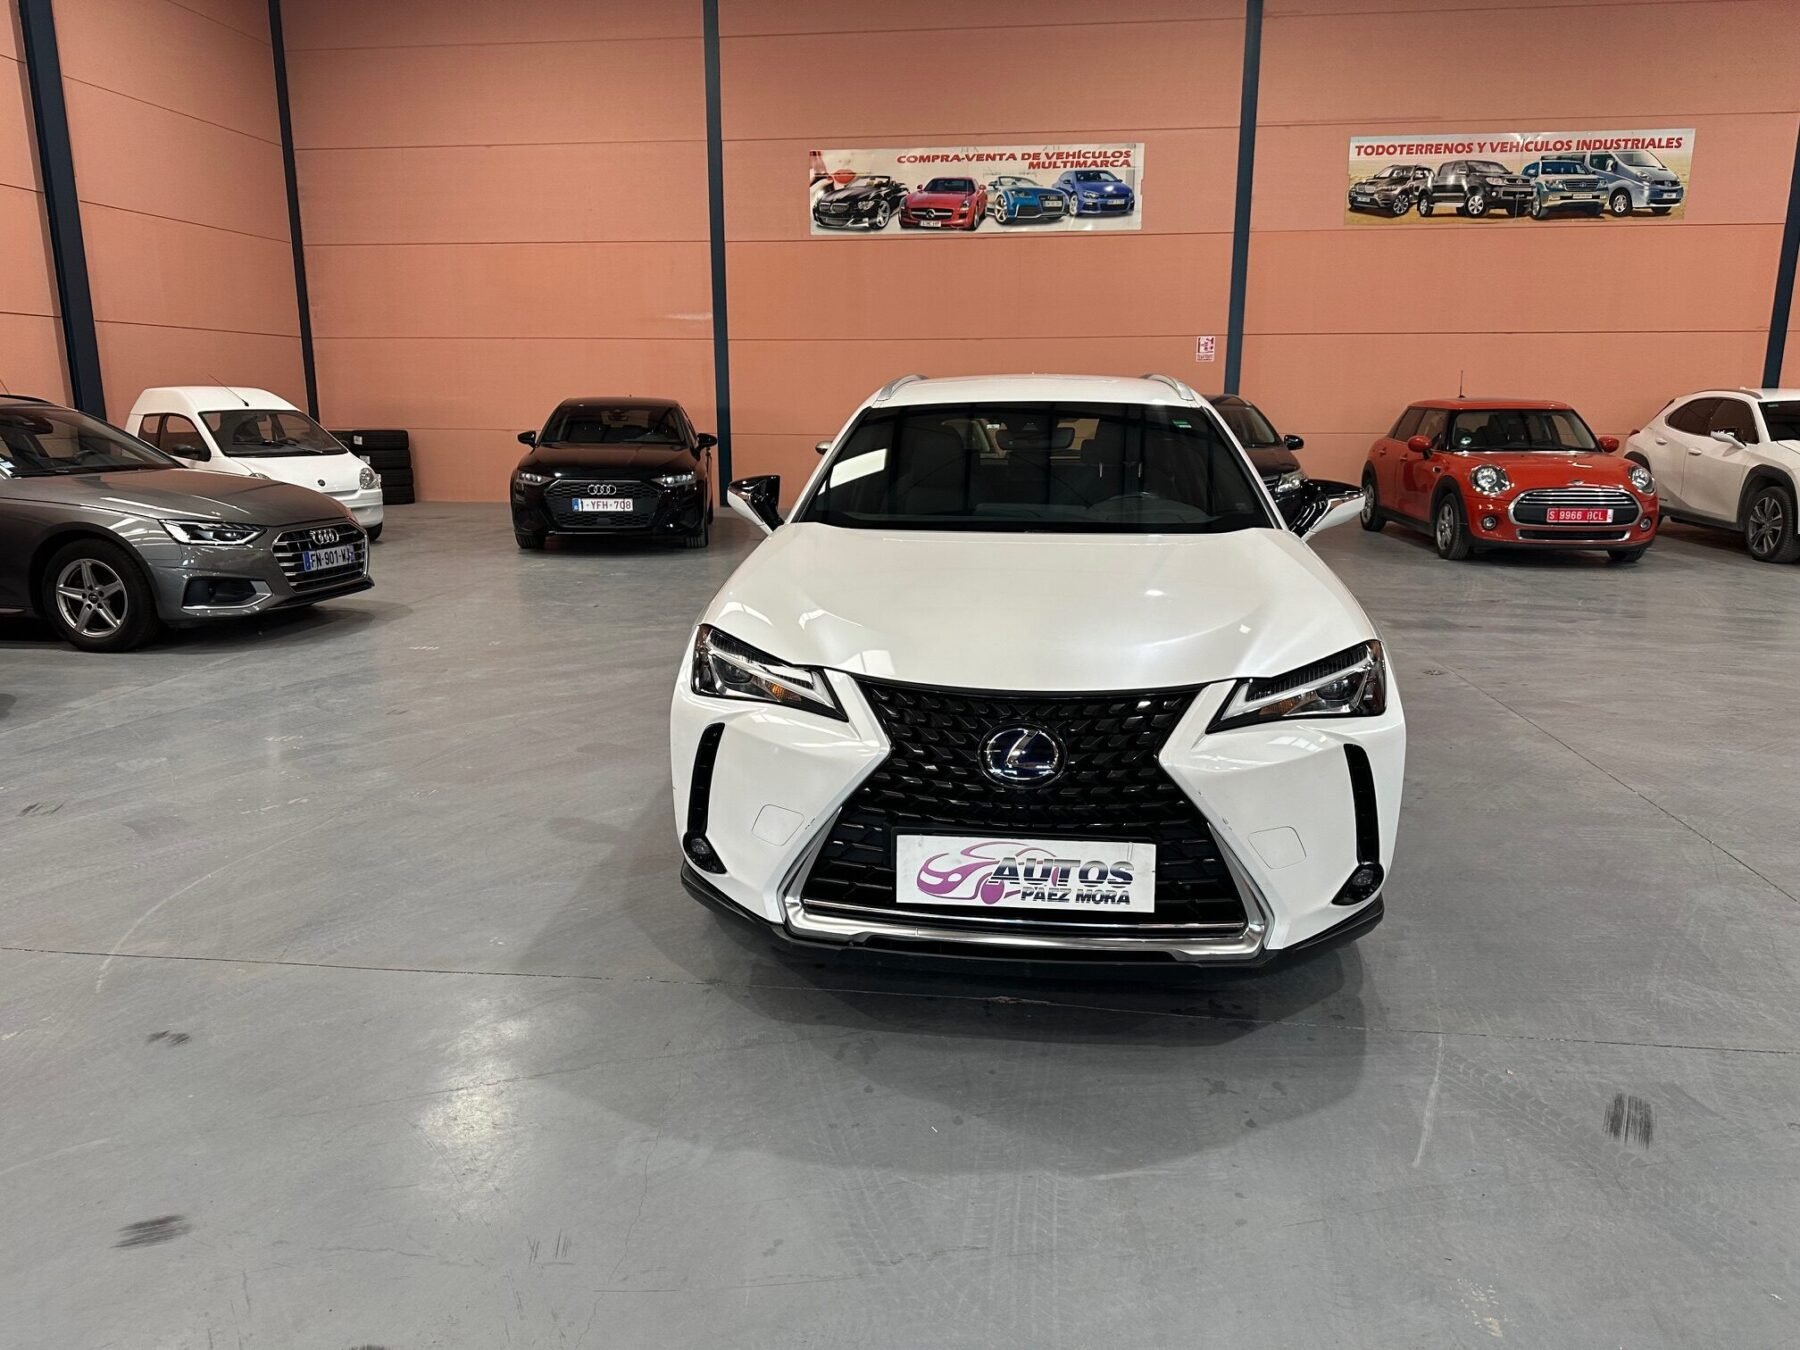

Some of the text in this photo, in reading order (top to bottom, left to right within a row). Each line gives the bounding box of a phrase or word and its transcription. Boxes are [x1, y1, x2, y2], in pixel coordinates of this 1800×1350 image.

[1355, 142, 1474, 156] TODOTERRENOS
[1478, 142, 1487, 153] Y
[1576, 137, 1683, 151] INDUSTRIALES
[896, 149, 1132, 164] COMPRA-VENTA DE VEHÍCULOS
[1027, 159, 1132, 170] MULTIMARCA
[1549, 510, 1555, 520] S
[1559, 510, 1583, 520] 9966
[988, 857, 1134, 888] AUTOS
[1075, 888, 1131, 905] MORA
